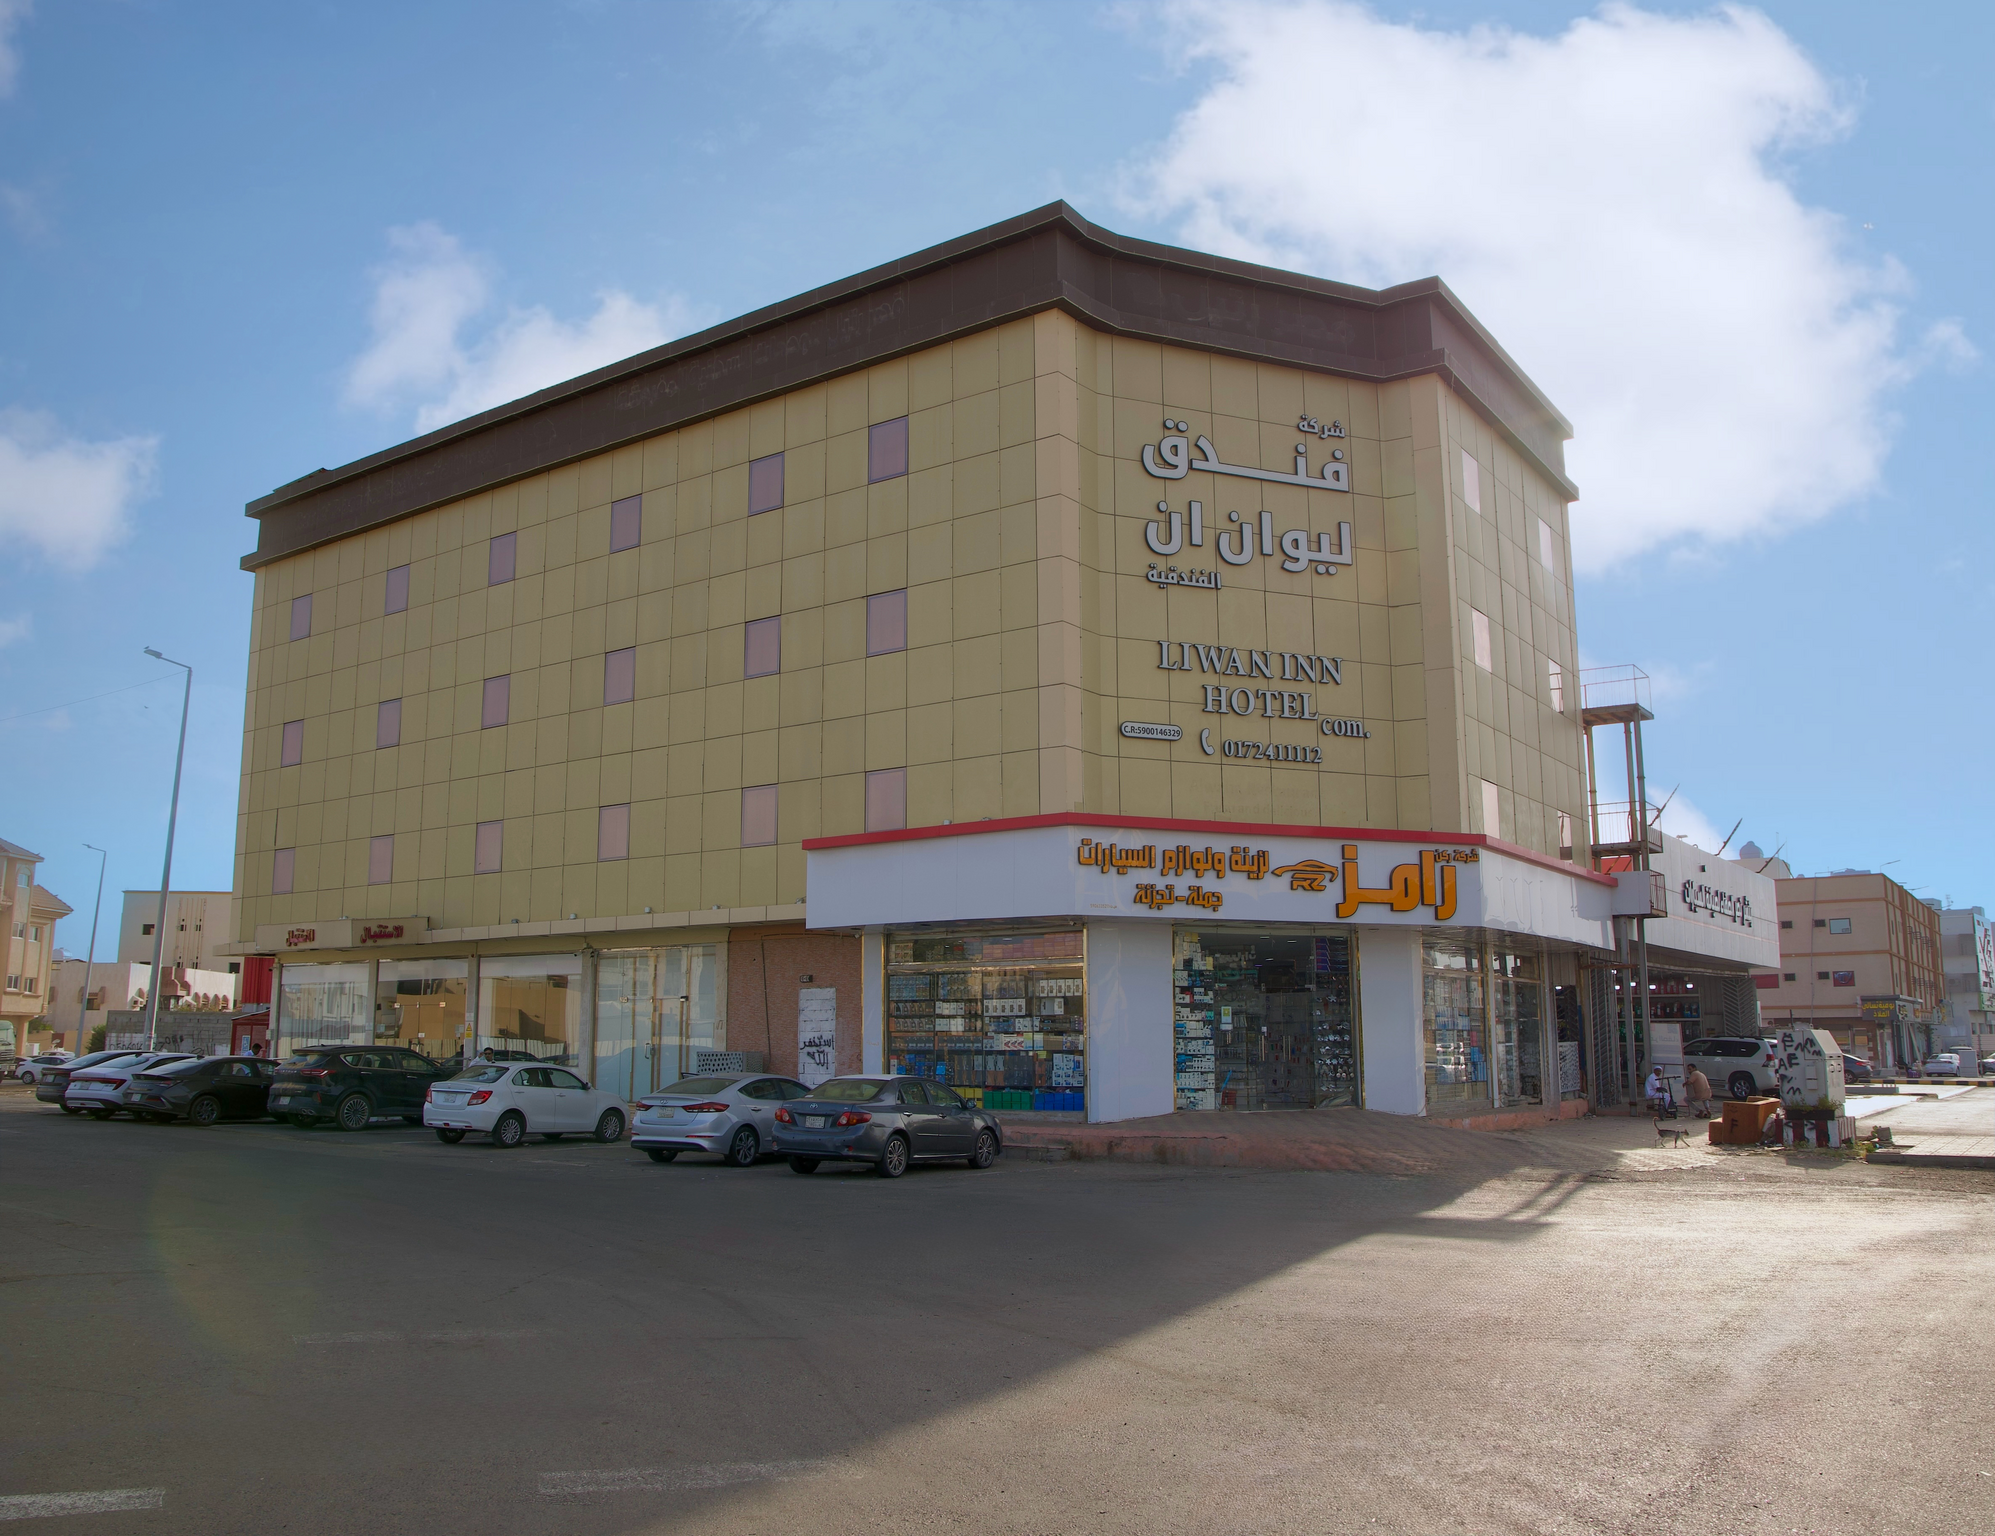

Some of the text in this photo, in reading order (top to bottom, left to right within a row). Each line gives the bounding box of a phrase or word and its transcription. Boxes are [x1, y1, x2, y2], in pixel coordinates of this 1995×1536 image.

[1298, 414, 1346, 439] شركة
[1142, 418, 1350, 493] فندق
[1145, 500, 1353, 575] ليوان ان
[1146, 562, 1222, 590] الفندقية
[1157, 640, 1343, 685] LIWAN INN
[1202, 684, 1319, 720] HOTEL
[1223, 739, 1323, 763] 0172411112
[1077, 837, 1270, 880] لزينة ولوازم السيارات
[1434, 848, 1480, 864] شركة ركن
[1335, 844, 1458, 921] رامز
[360, 923, 404, 944] الاستقبال
